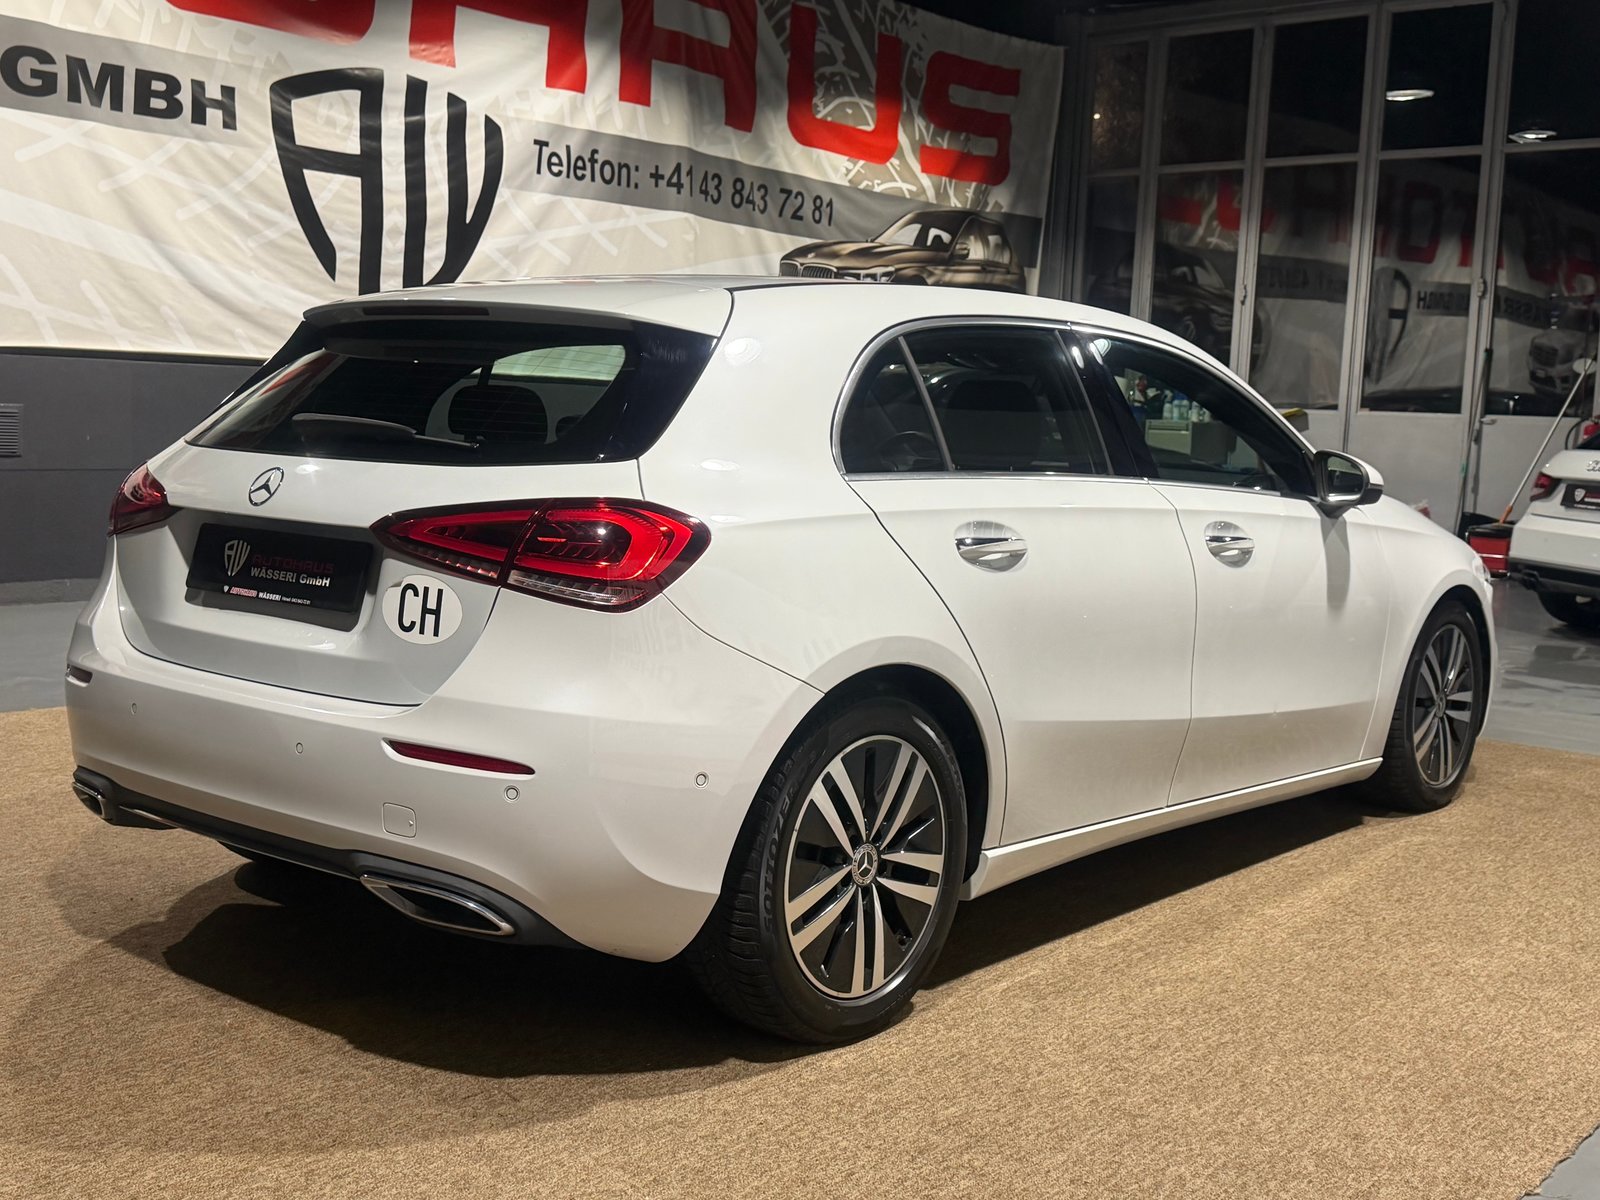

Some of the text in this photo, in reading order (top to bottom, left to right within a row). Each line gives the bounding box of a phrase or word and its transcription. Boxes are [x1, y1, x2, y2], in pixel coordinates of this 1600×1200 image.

[1, 45, 238, 131] GMBH
[532, 138, 835, 227] Telefon: +41 43 843 72 81
[250, 553, 335, 575] AUTOHAUS
[299, 573, 331, 587] GmbH
[398, 583, 444, 637] CH
